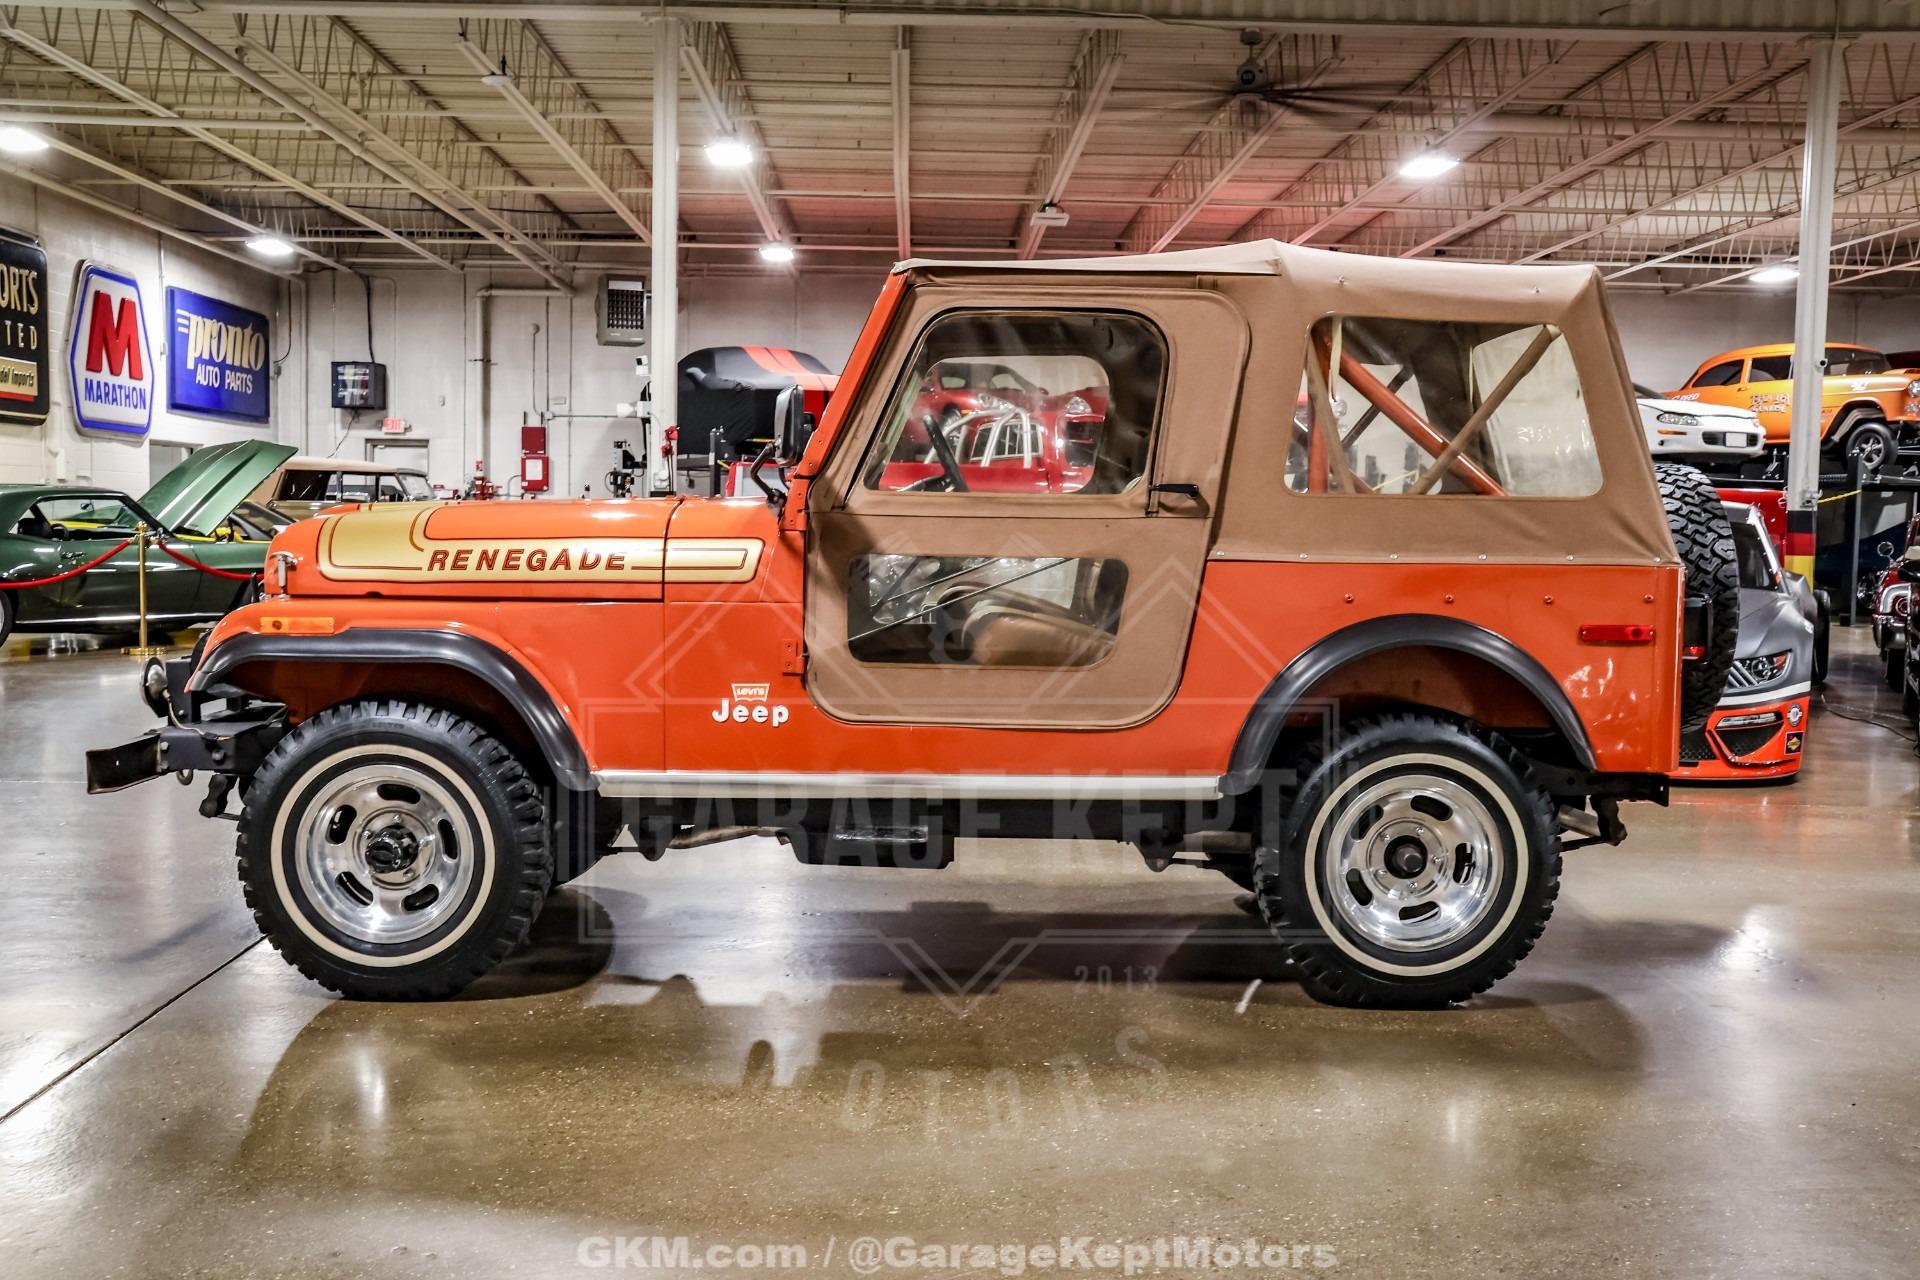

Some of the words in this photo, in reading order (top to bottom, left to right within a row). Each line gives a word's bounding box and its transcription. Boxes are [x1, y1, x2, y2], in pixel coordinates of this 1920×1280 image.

[0, 263, 39, 315] ORTS
[5, 320, 38, 350] TED
[86, 290, 144, 381] M
[187, 313, 266, 371] pronto
[85, 378, 147, 410] MARATHON
[196, 363, 220, 389] AUTO
[225, 370, 253, 395] PARTS
[428, 548, 627, 572] RENEGADE
[712, 698, 789, 727] Jeep
